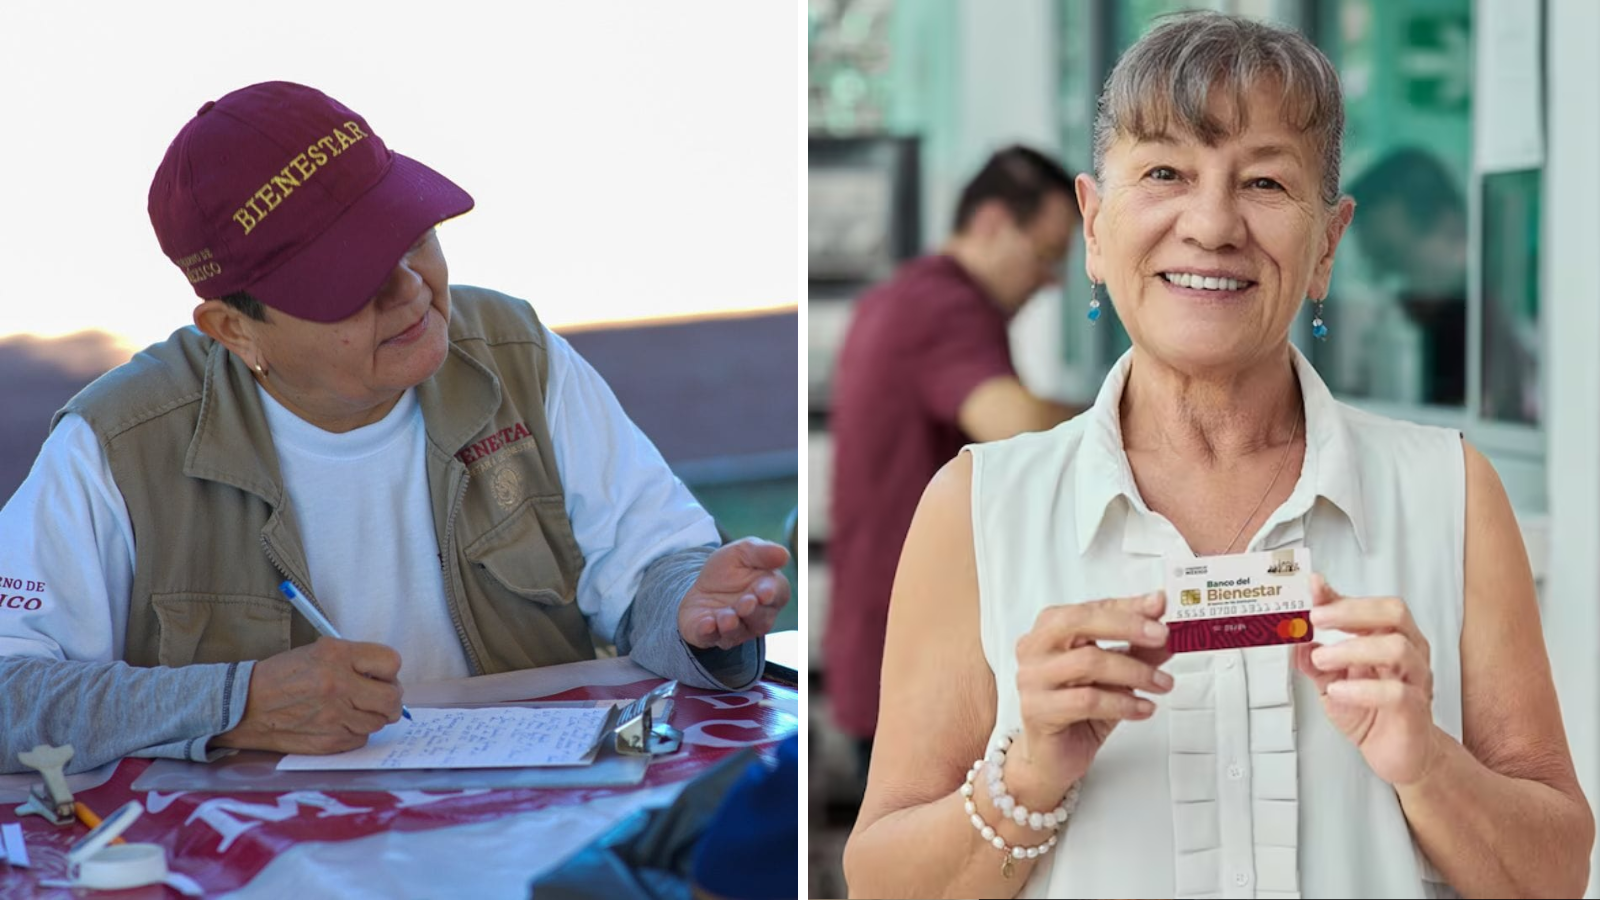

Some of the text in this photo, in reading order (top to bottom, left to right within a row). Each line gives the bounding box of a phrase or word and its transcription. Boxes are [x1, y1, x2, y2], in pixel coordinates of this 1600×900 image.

[233, 121, 368, 235] BIENESTAR
[26, 580, 46, 592] DE
[1206, 577, 1251, 588] Banco del
[1207, 584, 1283, 601] Bienestar
[1209, 605, 1237, 616] 0700
